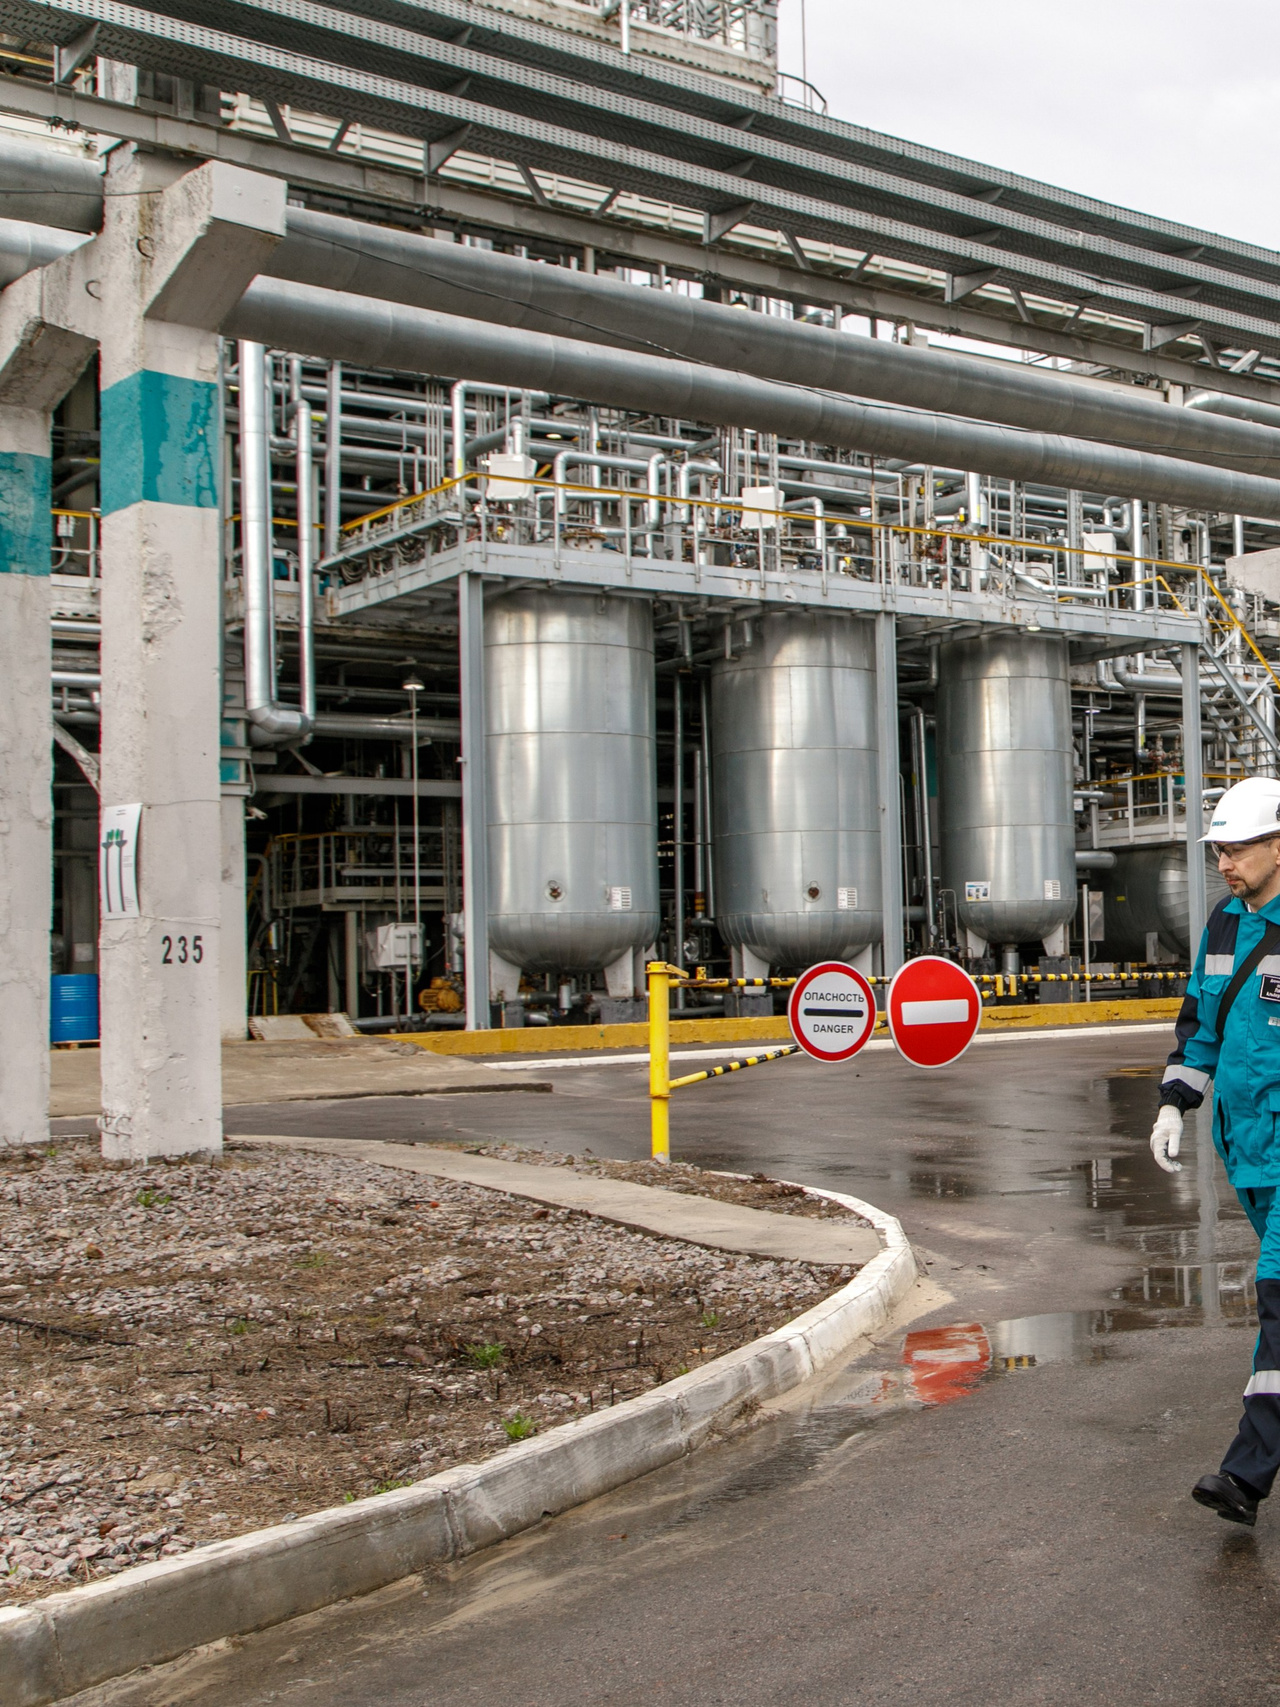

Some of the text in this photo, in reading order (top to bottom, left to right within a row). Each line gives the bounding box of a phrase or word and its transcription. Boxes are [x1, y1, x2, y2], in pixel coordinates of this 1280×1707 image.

[161, 935, 203, 964] 235
[804, 991, 865, 1003] ОПАСНОСТЬ
[813, 1024, 854, 1034] DANGER
